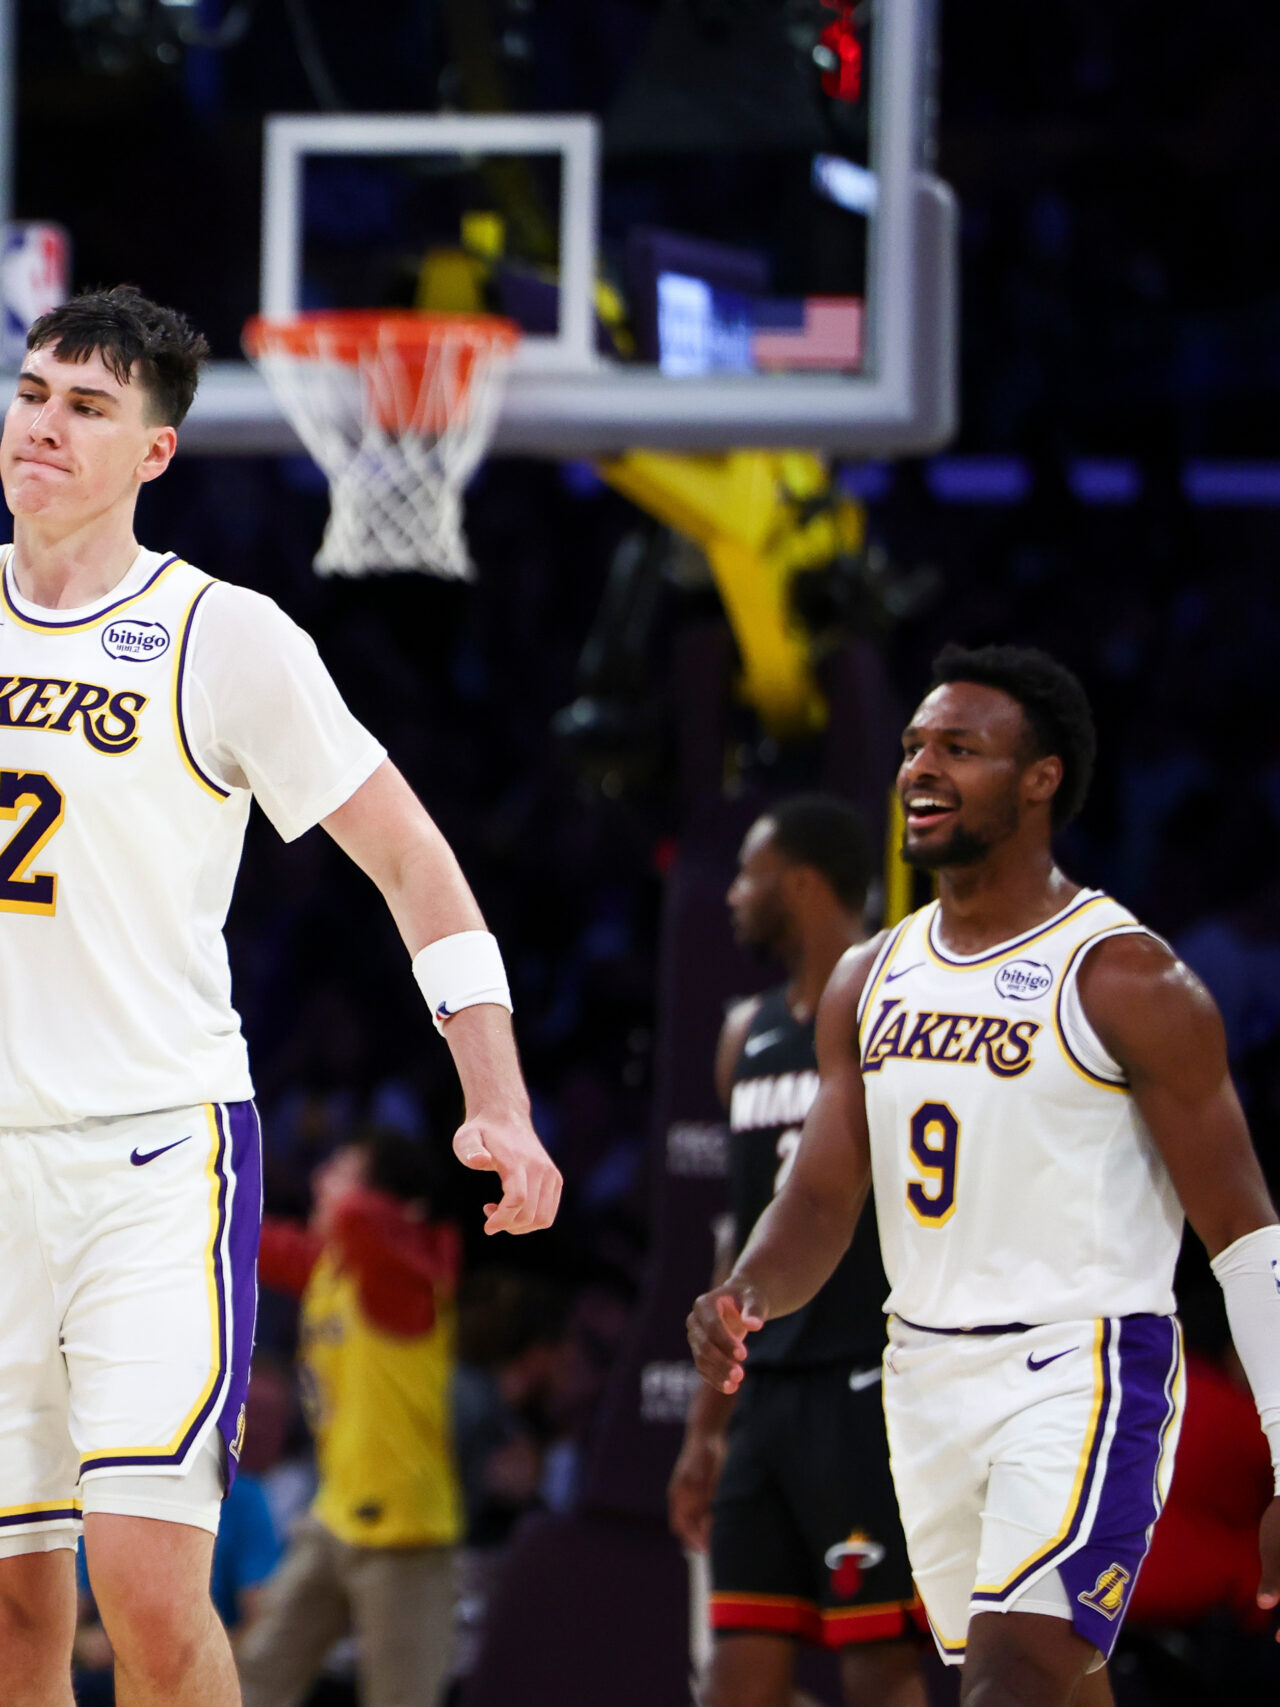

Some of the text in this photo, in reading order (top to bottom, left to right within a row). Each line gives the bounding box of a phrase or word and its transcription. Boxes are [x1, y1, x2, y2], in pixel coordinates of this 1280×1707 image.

[109, 629, 166, 651] bibigo
[1001, 969, 1049, 991] bibigo
[860, 998, 1043, 1079] LAKERS
[905, 1100, 960, 1229] 9
